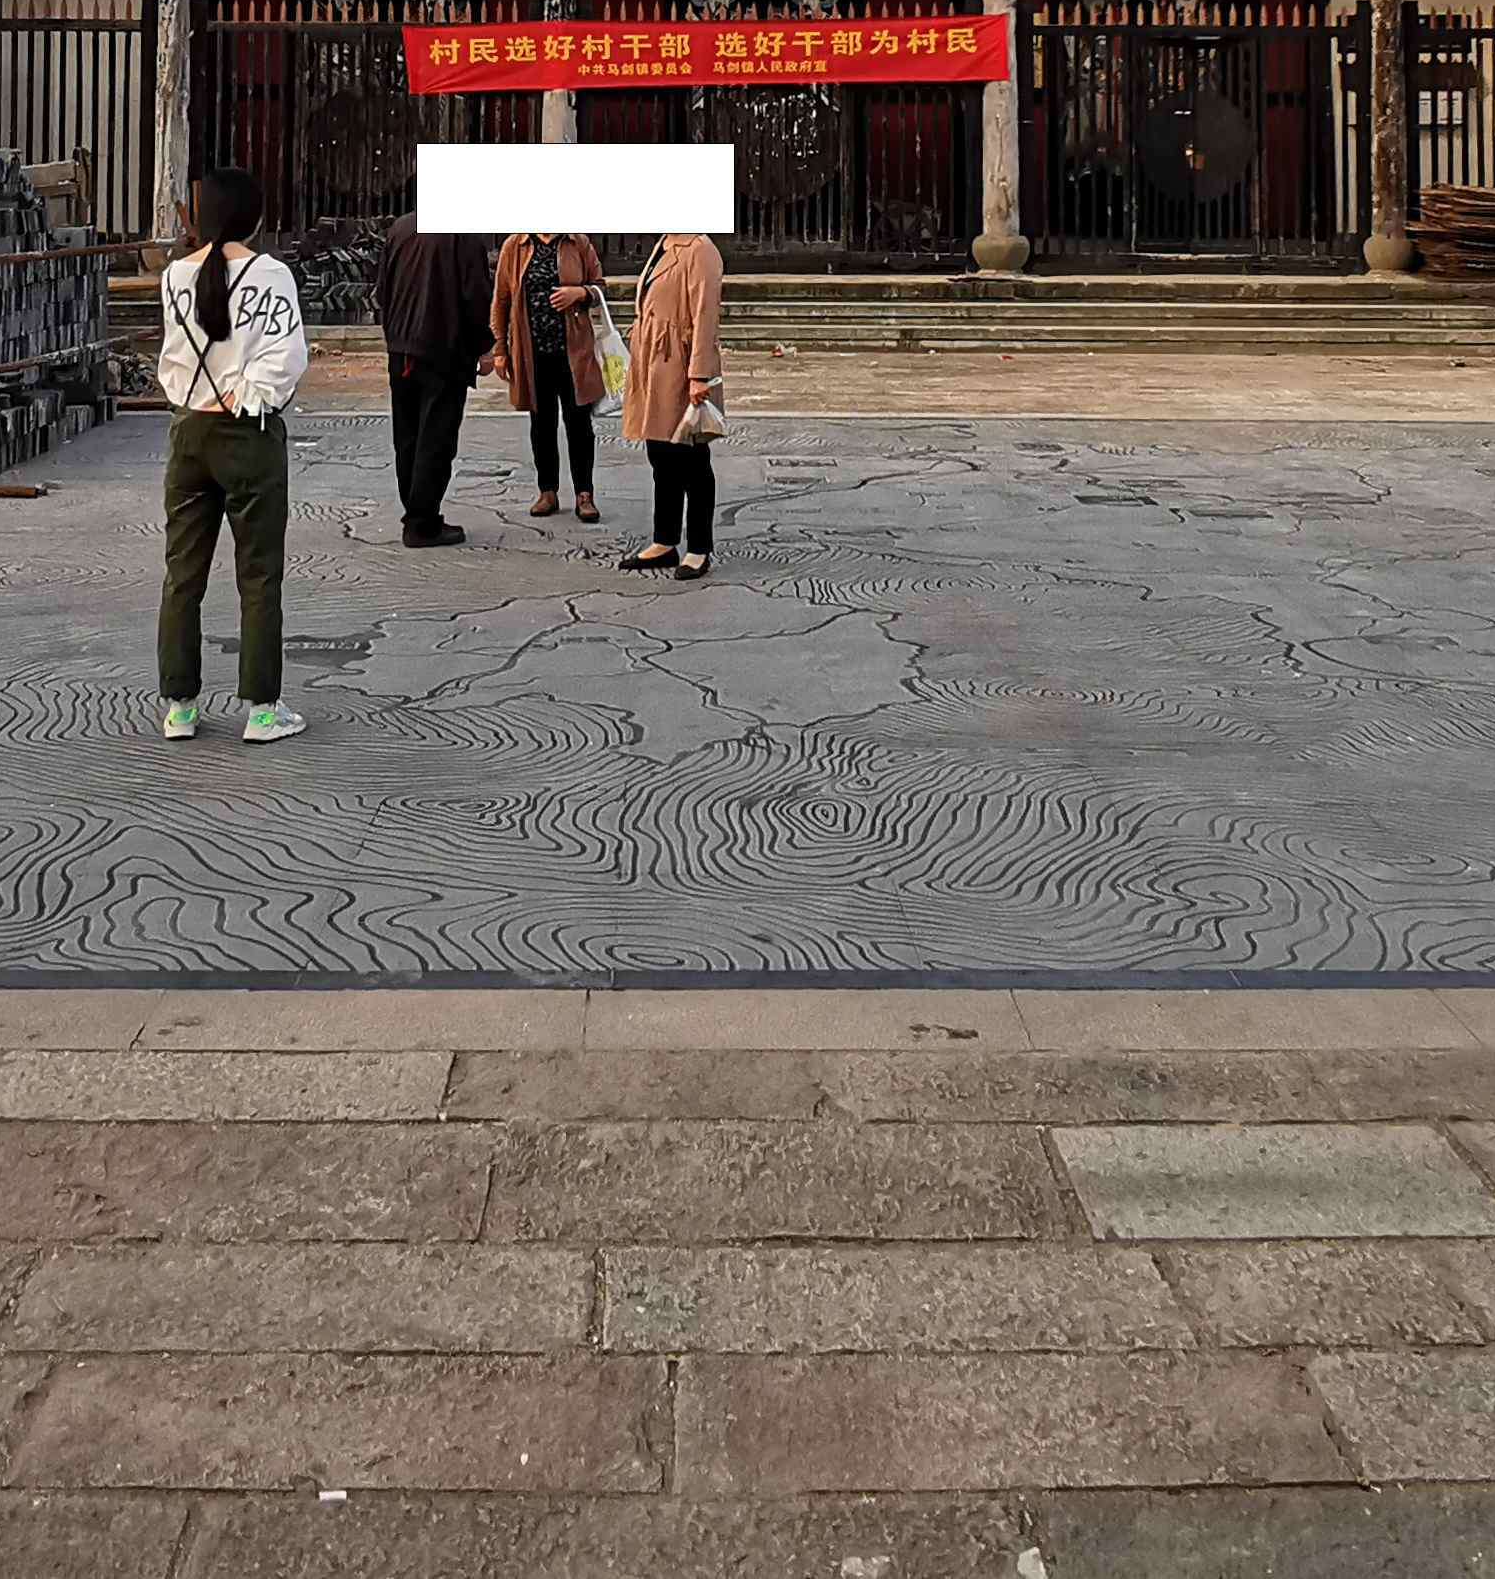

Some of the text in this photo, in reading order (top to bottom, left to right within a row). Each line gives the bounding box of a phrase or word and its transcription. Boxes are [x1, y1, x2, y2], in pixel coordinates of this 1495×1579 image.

[428, 27, 979, 65] 村民选好村干部 选好干部为村民
[577, 60, 828, 77] 中共马剑镇委员会 马剑镇人民政府宣
[234, 285, 300, 335] BABY
